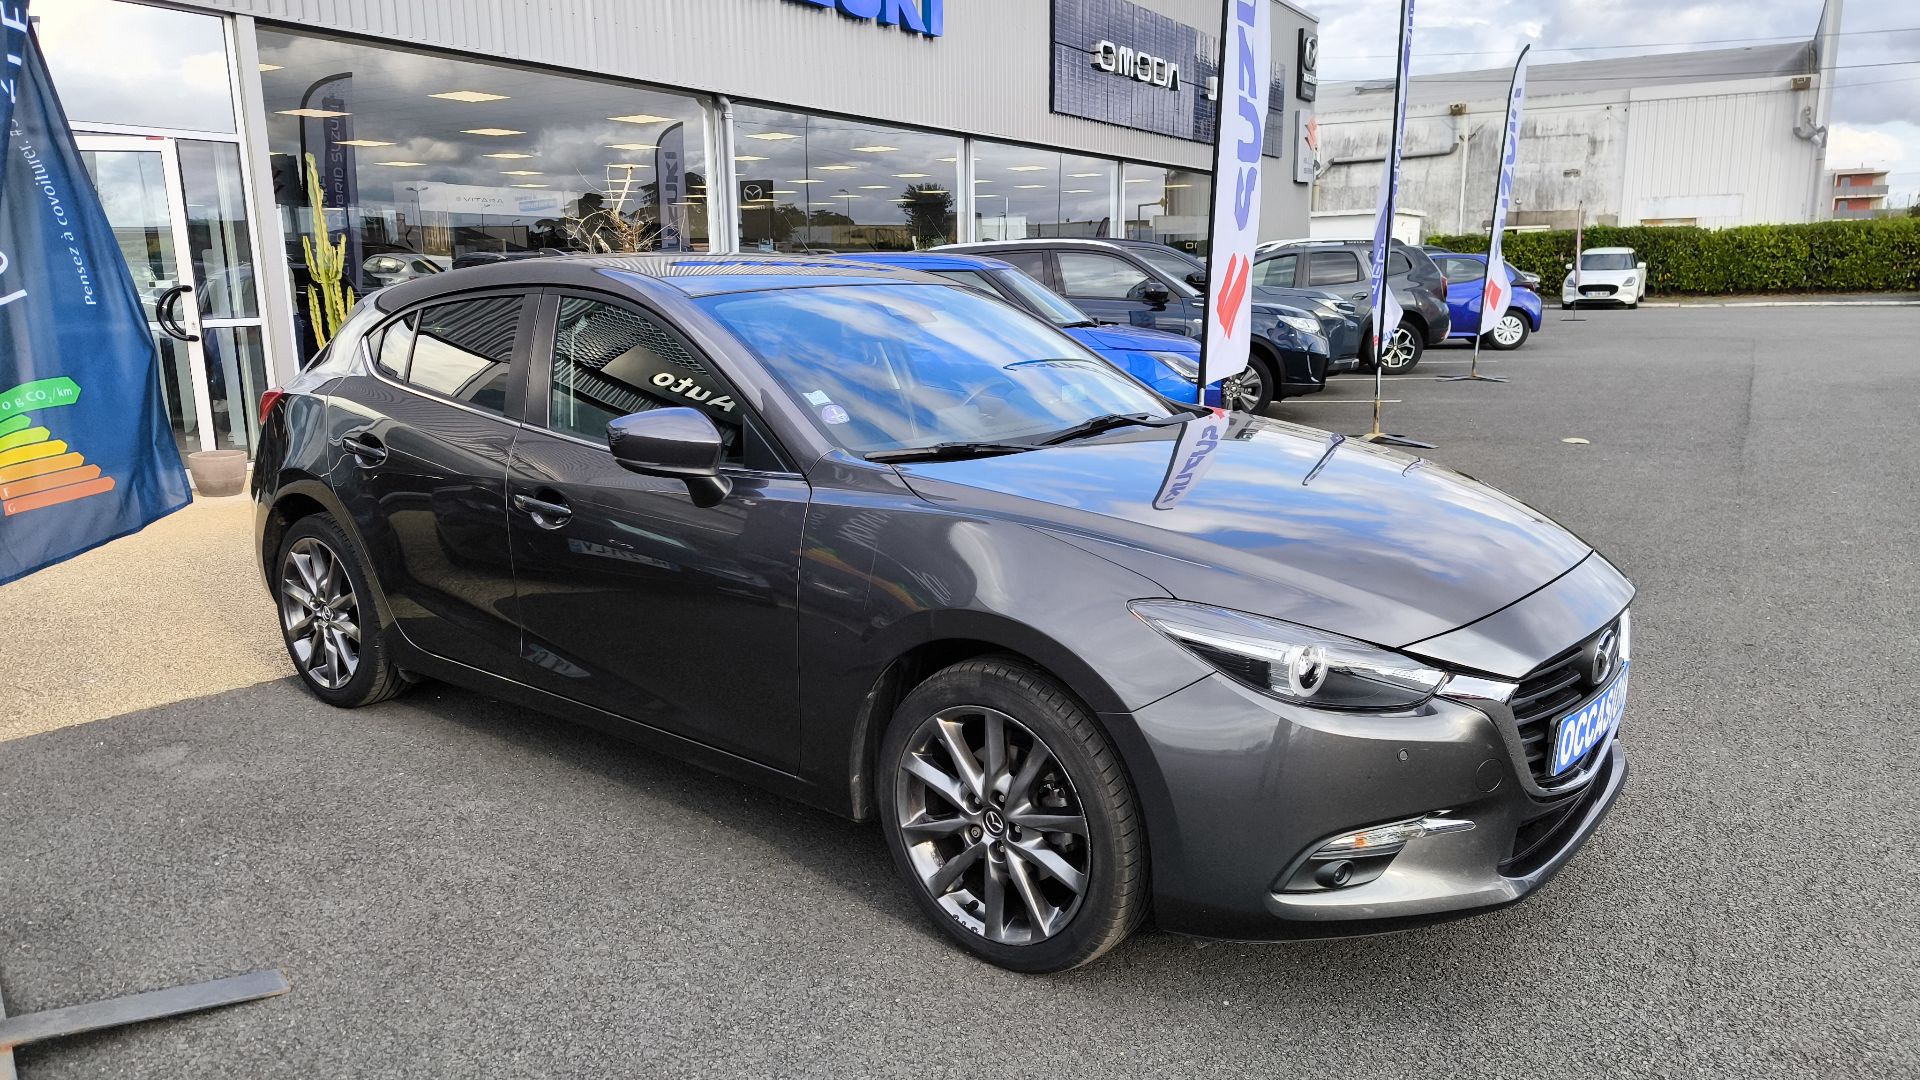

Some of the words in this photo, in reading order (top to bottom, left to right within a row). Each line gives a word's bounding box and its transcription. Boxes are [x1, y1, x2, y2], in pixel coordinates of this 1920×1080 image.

[1094, 39, 1181, 91] OMODA
[19, 140, 69, 226] covoiturer.
[61, 230, 74, 241] à
